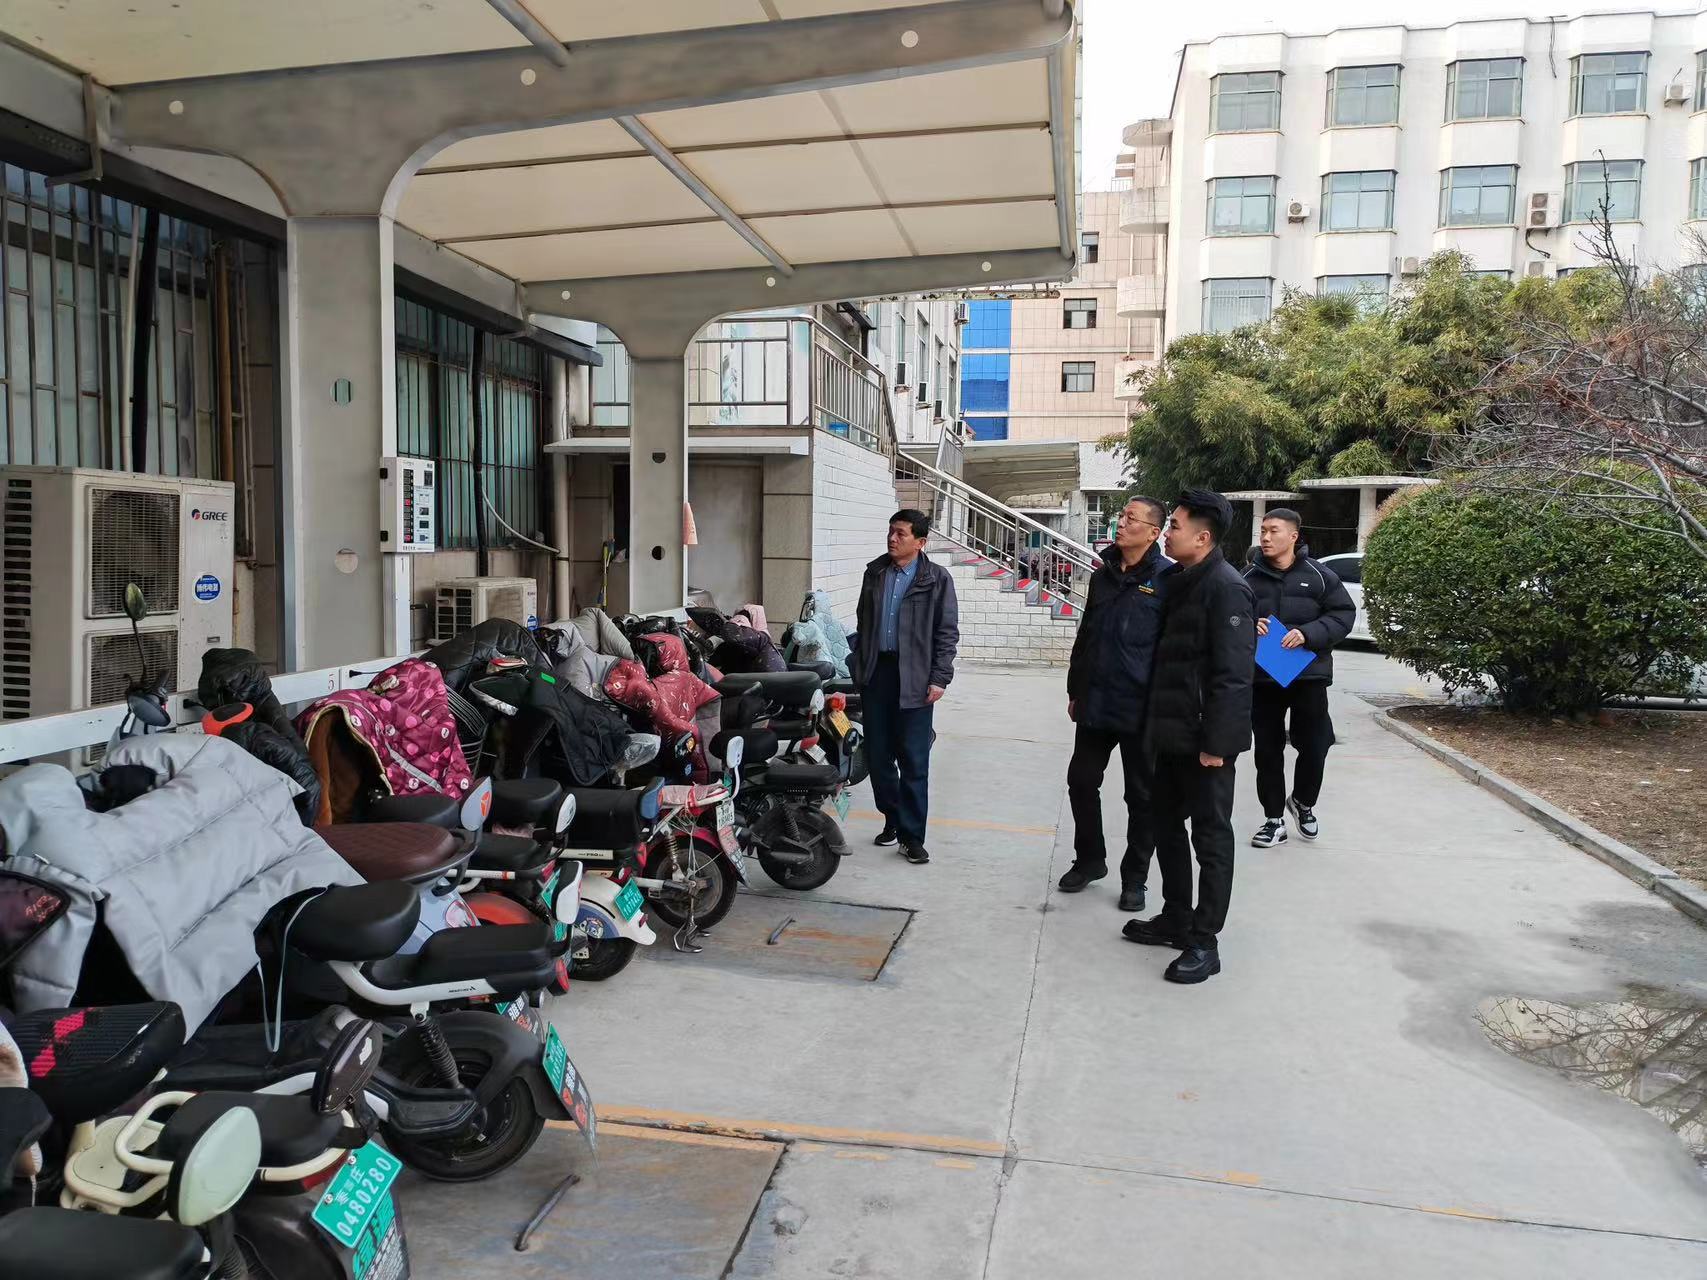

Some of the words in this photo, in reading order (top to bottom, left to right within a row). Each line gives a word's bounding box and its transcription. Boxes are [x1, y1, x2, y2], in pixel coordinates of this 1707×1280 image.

[202, 511, 228, 521] GREE
[327, 673, 335, 691] 5
[336, 1157, 392, 1237] 0480280
